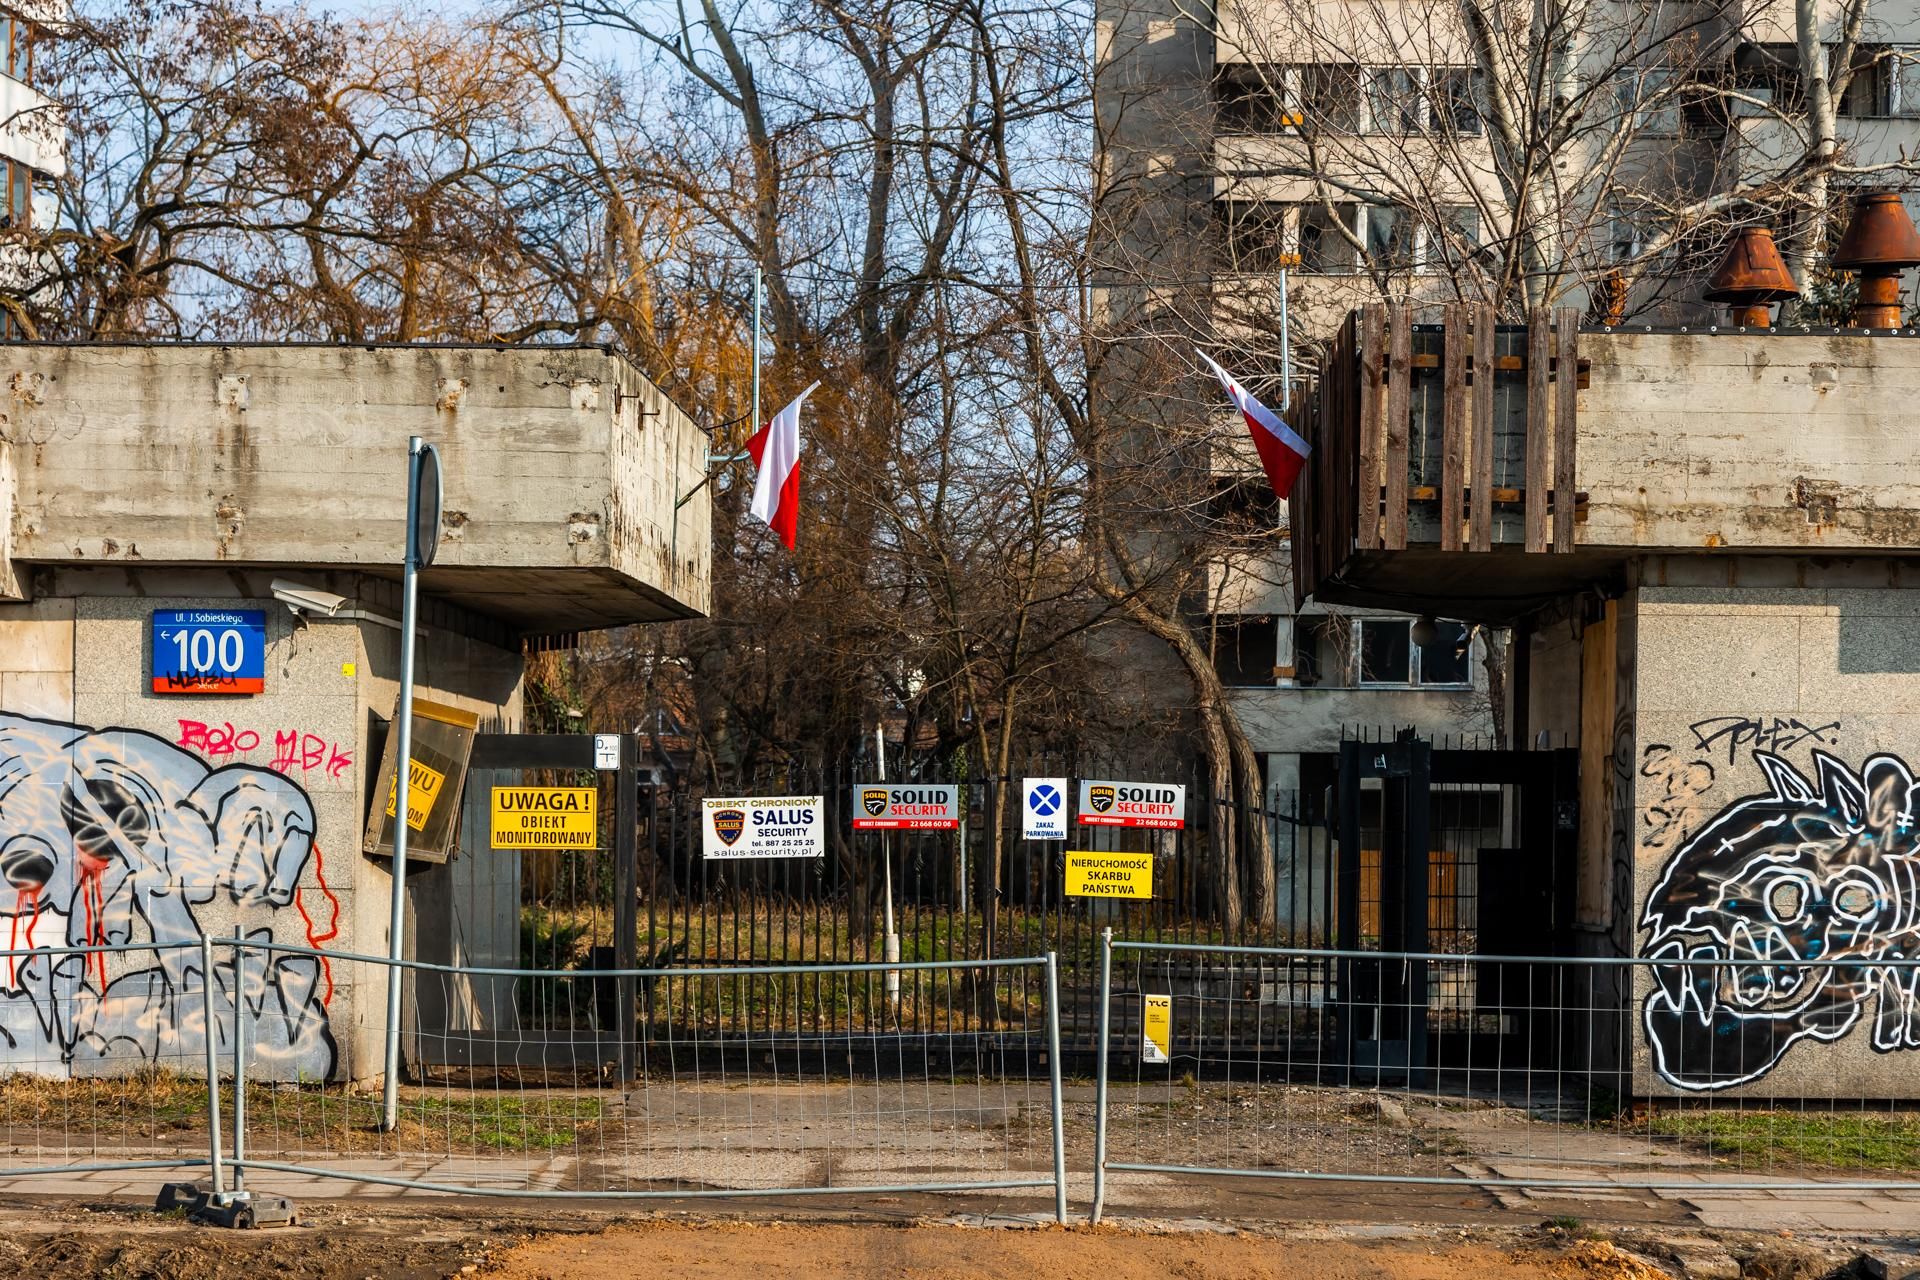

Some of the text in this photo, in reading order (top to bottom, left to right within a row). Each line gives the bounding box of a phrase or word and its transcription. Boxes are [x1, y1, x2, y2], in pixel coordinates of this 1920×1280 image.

[175, 613, 186, 622] Ul.
[172, 629, 244, 672] 100
[500, 792, 578, 810] UWAGA
[891, 790, 948, 804] SOLID
[1118, 788, 1176, 804] SOLID
[750, 799, 818, 808] CHRONIONY
[1116, 802, 1174, 814] SECURITY
[890, 805, 948, 816] SECURITY
[521, 816, 566, 828] OBIEKT
[752, 809, 814, 825] SALUS
[496, 831, 592, 844] MONITOROWANY
[758, 828, 808, 837] SECURITY
[714, 848, 812, 856] salus-security.pl
[1072, 858, 1148, 869] NIERUCHOMOŚĆ
[1088, 871, 1131, 881] SKARBU
[1082, 882, 1134, 894] PAŃSTWA
